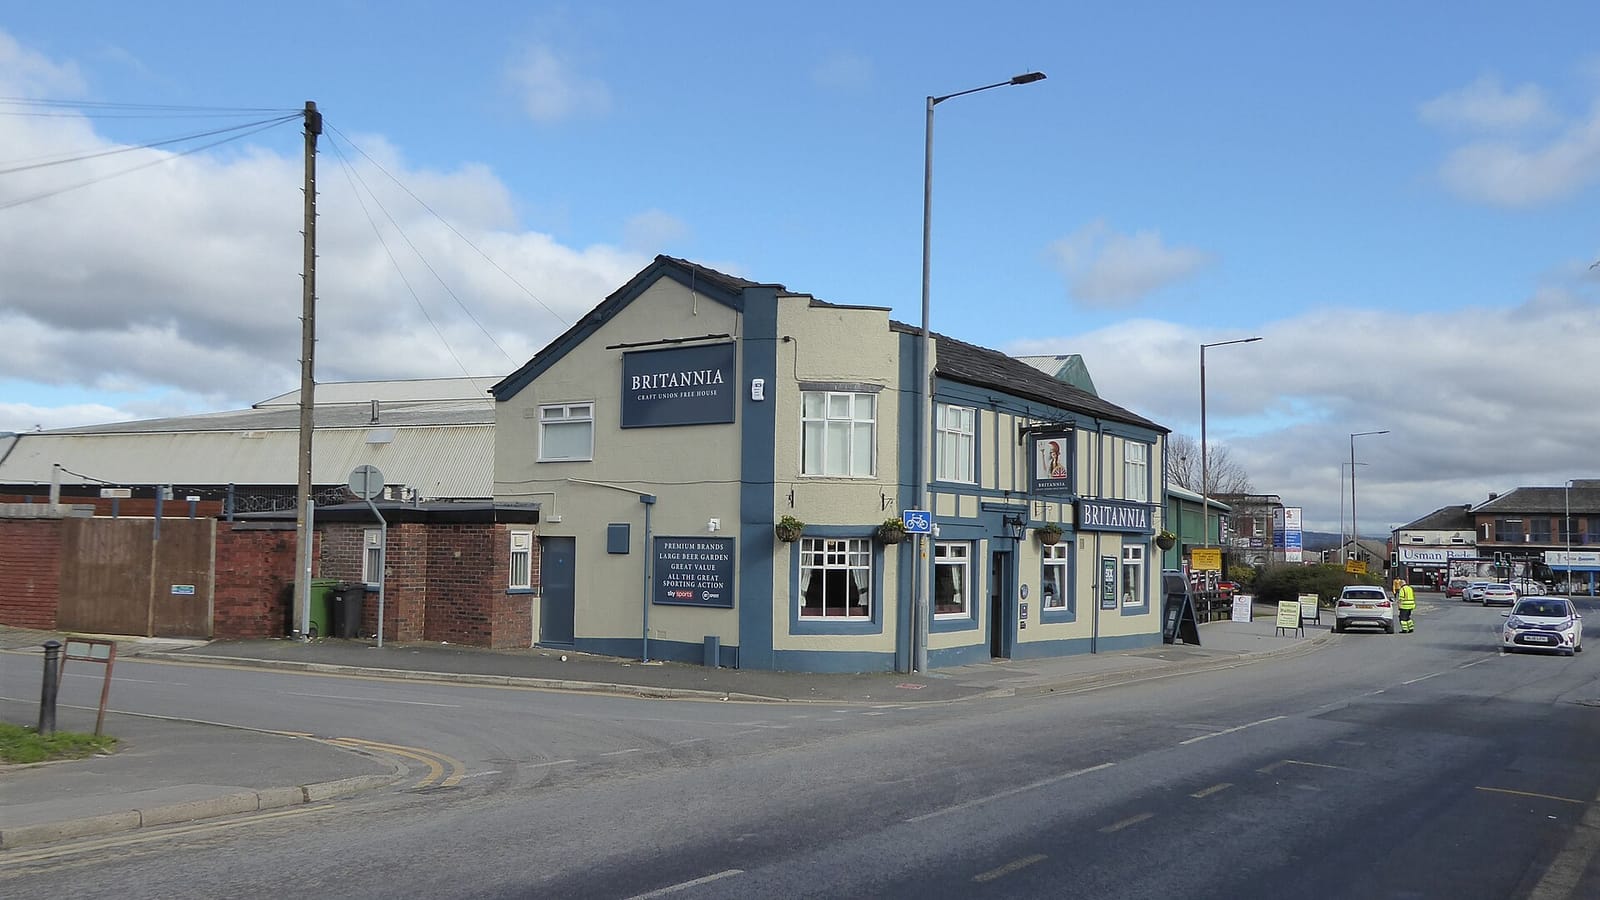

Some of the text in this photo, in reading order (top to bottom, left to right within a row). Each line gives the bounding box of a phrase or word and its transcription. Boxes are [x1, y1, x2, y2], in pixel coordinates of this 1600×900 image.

[631, 369, 724, 390] BRITANNIA
[637, 393, 657, 401] CRAFT
[658, 392, 679, 400] UNION
[1084, 504, 1146, 528] BRITANNIA
[697, 543, 724, 551] BRANDS
[1404, 549, 1442, 560] Usman
[663, 580, 695, 588] SPORTING
